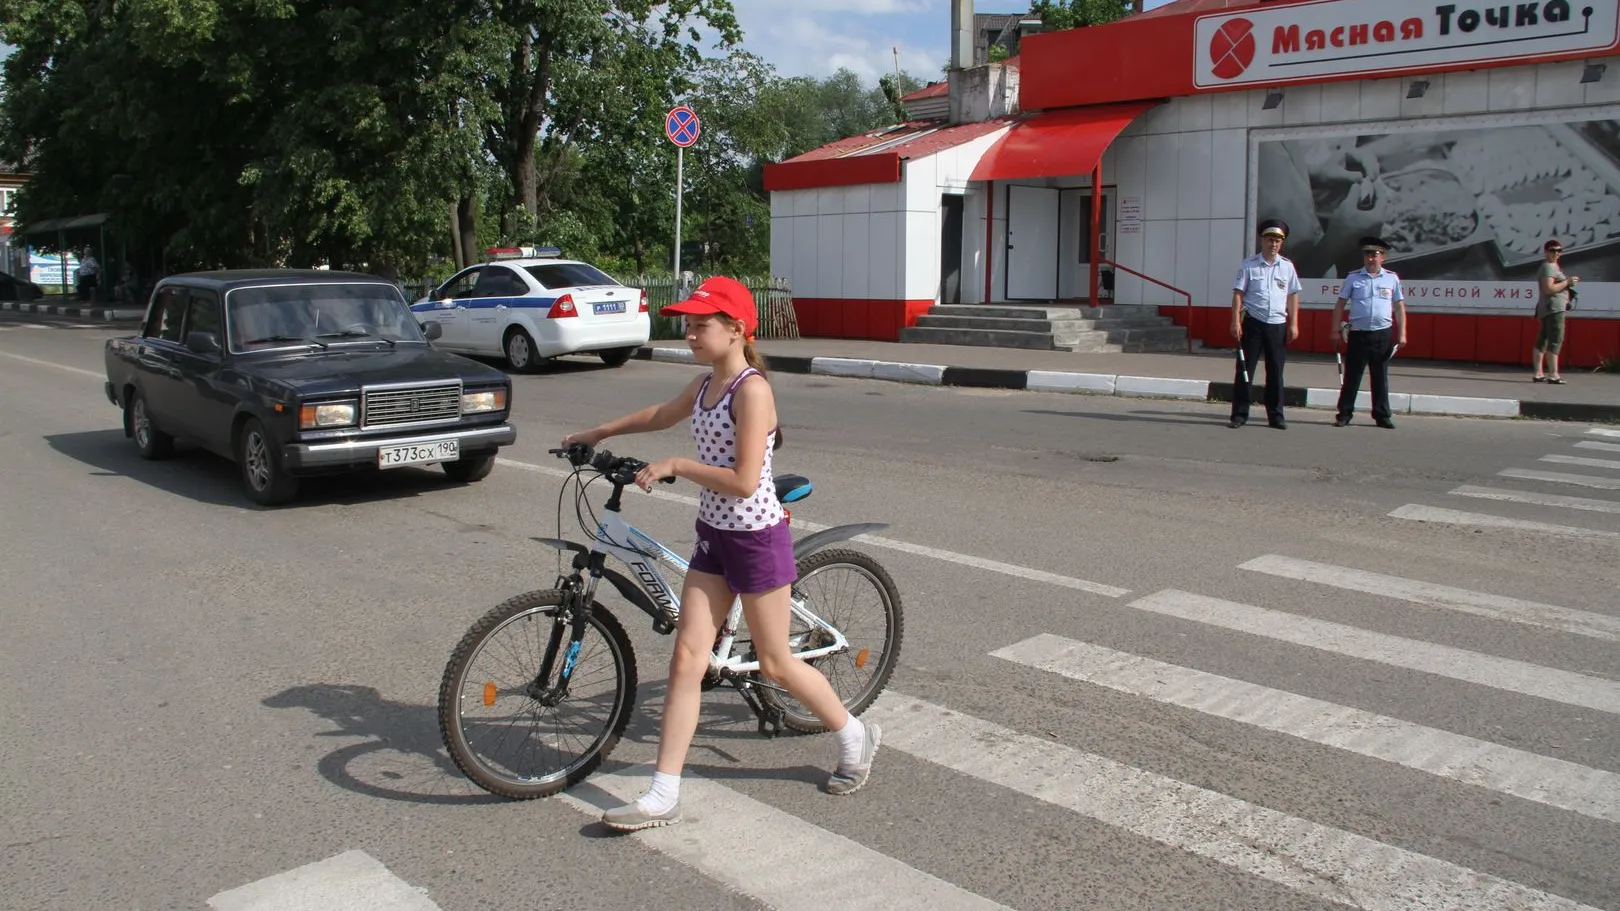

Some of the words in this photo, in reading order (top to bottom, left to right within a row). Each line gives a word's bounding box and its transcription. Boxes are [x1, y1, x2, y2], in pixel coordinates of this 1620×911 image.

[1272, 17, 1423, 54] Мясная
[1436, 0, 1570, 35] Точка
[1494, 288, 1534, 299] ЖИЗ
[437, 442, 456, 453] 190
[630, 562, 680, 621] FORWA
